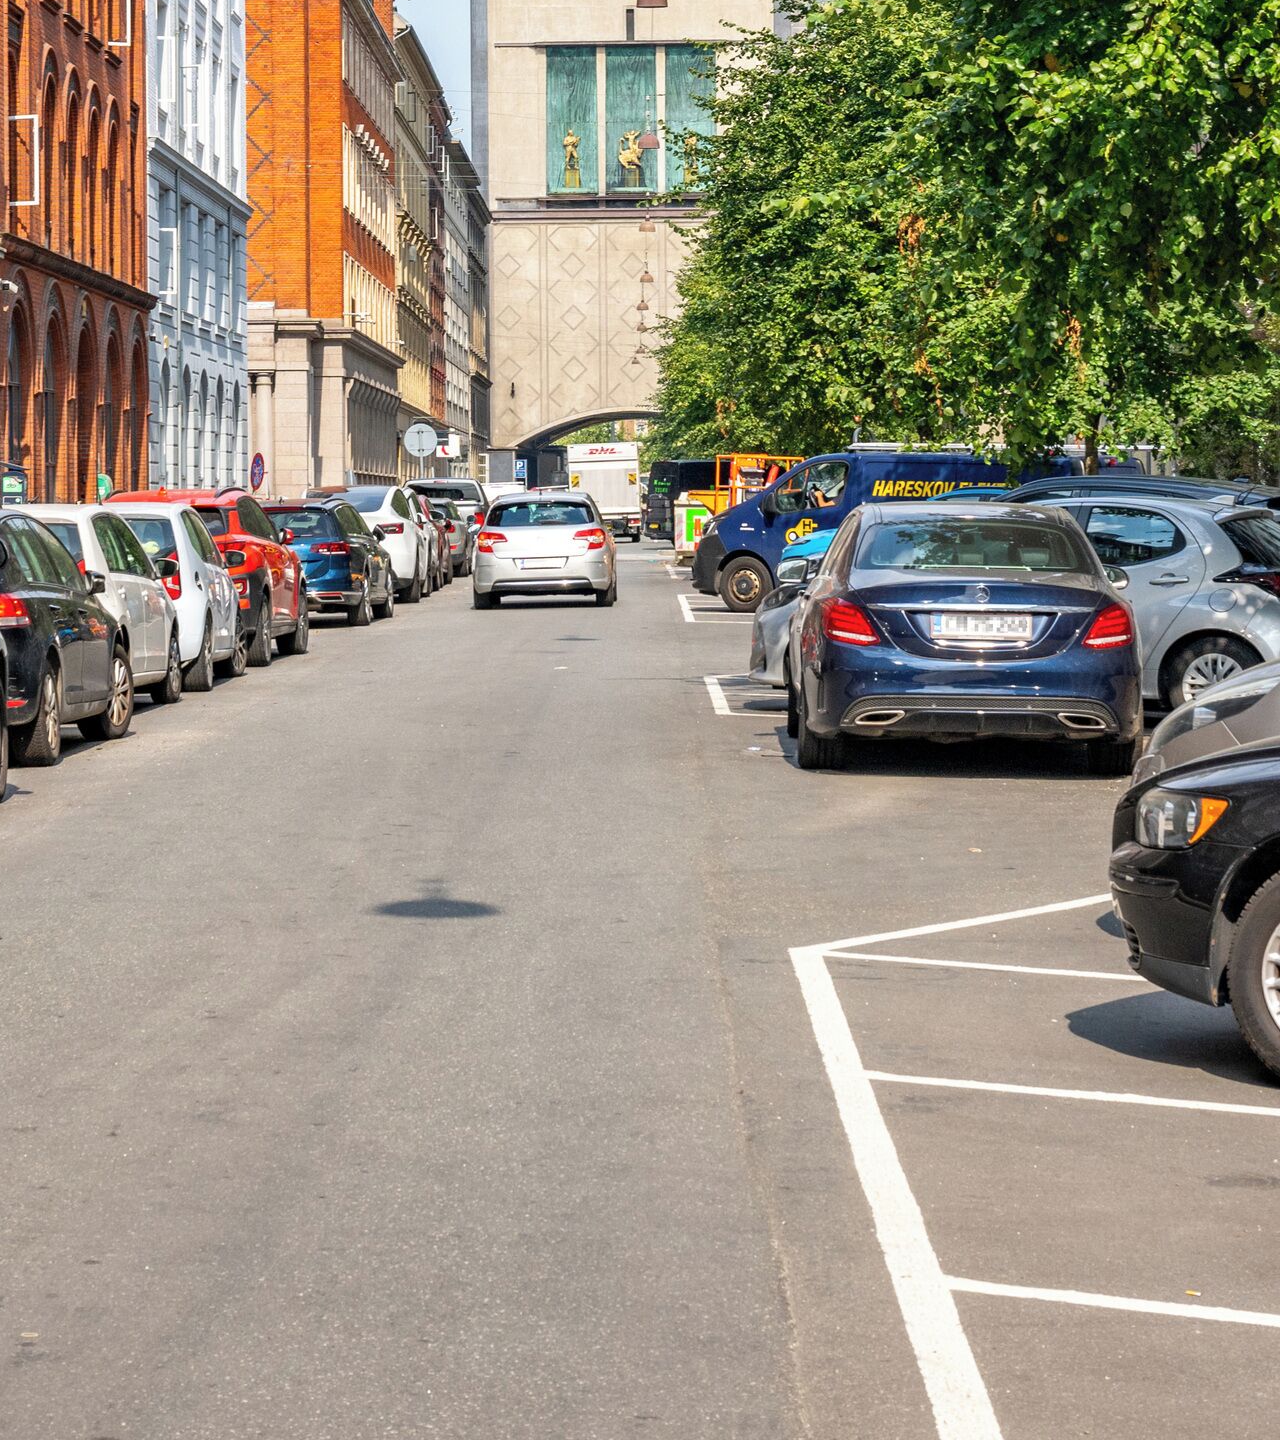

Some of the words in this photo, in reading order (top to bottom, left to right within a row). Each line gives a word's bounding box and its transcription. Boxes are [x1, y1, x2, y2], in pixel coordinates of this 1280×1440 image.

[588, 447, 617, 455] DHL
[516, 461, 523, 470] P
[872, 480, 955, 497] HARESKOV
